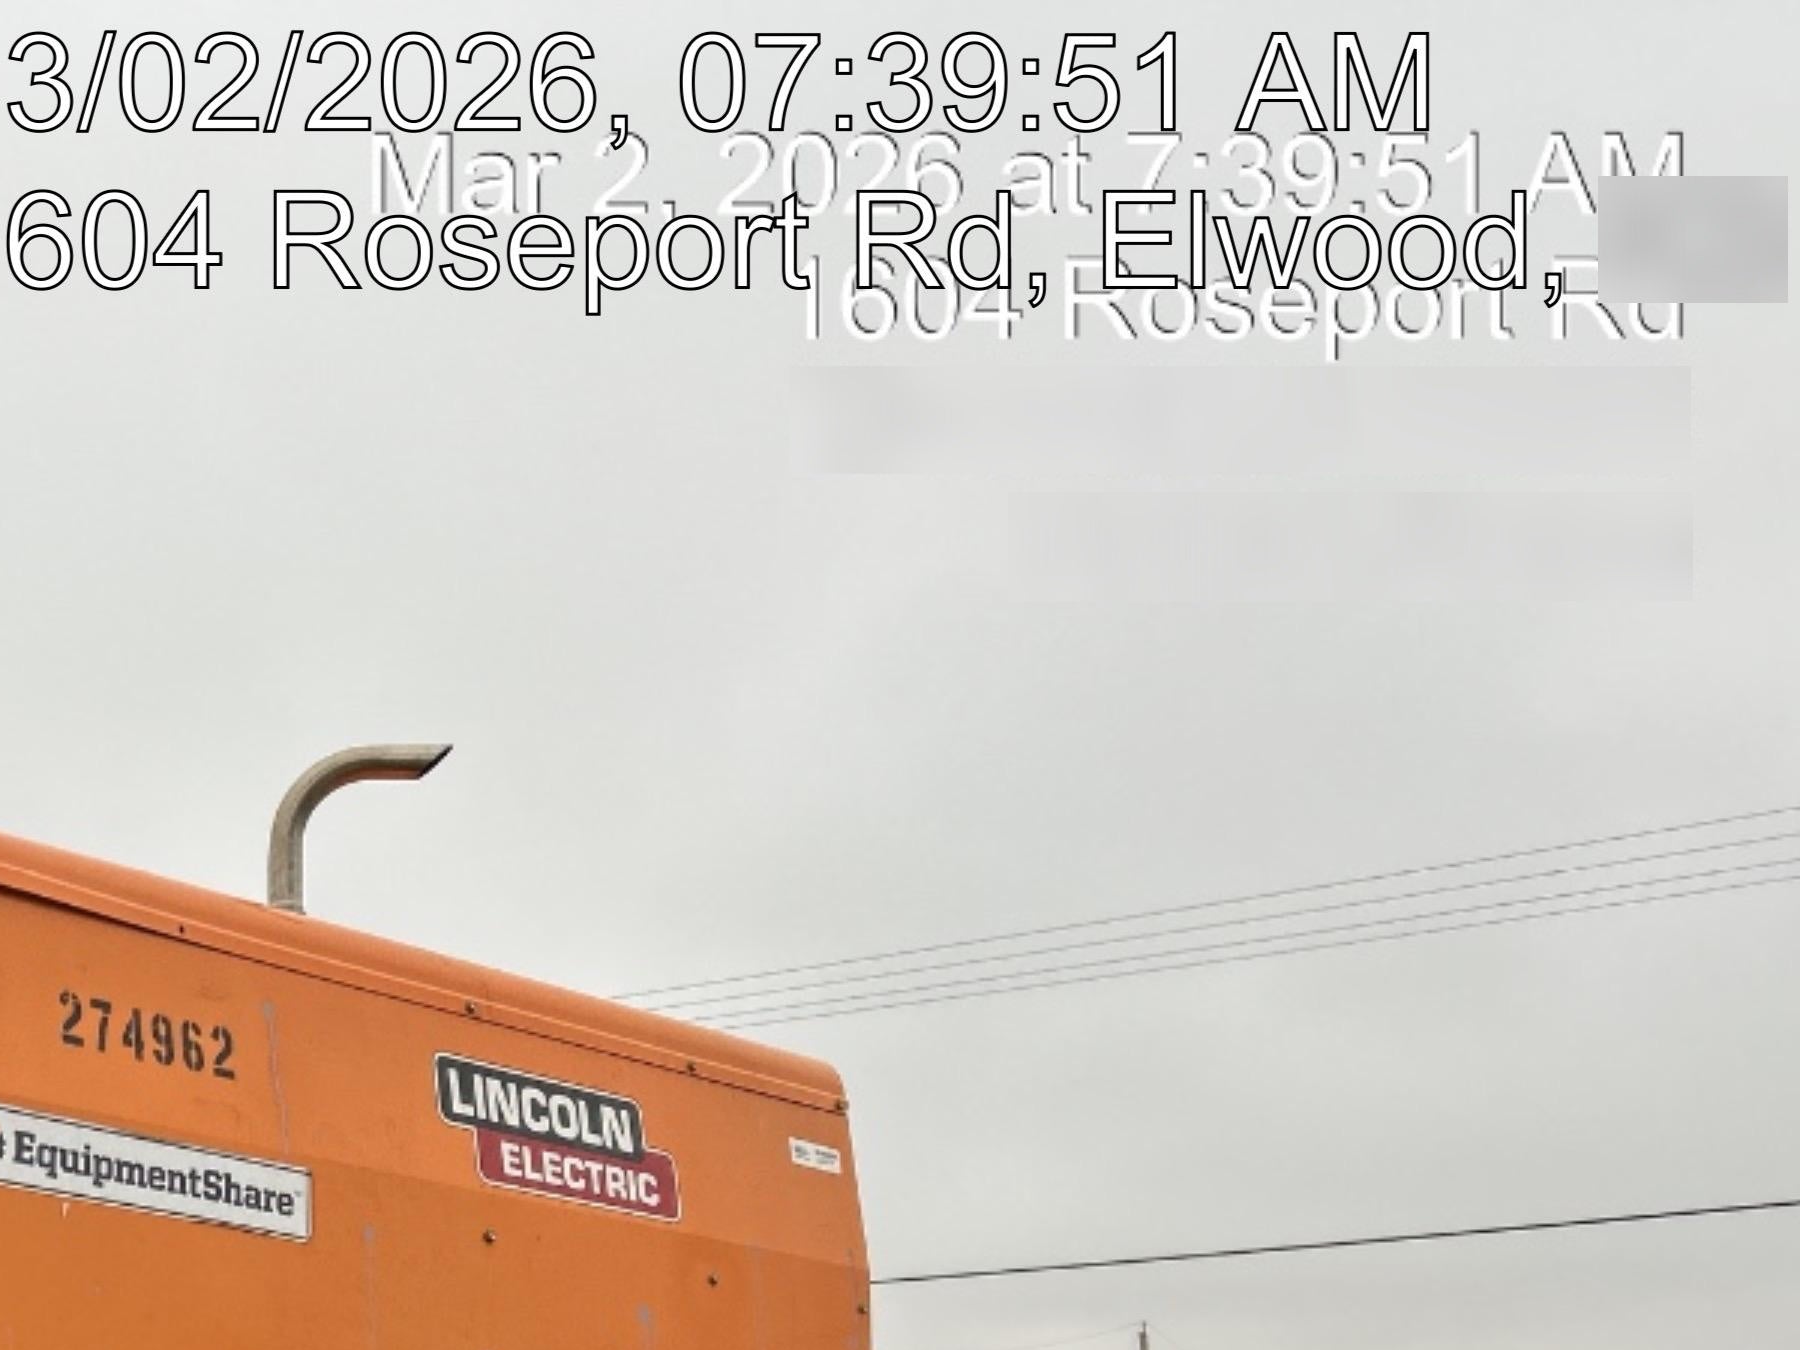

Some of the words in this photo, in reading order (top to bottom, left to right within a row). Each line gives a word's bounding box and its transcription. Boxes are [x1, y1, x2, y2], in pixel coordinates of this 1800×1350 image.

[59, 988, 237, 1080] 274962
[447, 1066, 635, 1154] LINCOLN
[12, 1130, 296, 1218] EquipmentShare
[499, 1141, 660, 1208] ELECTRIC
